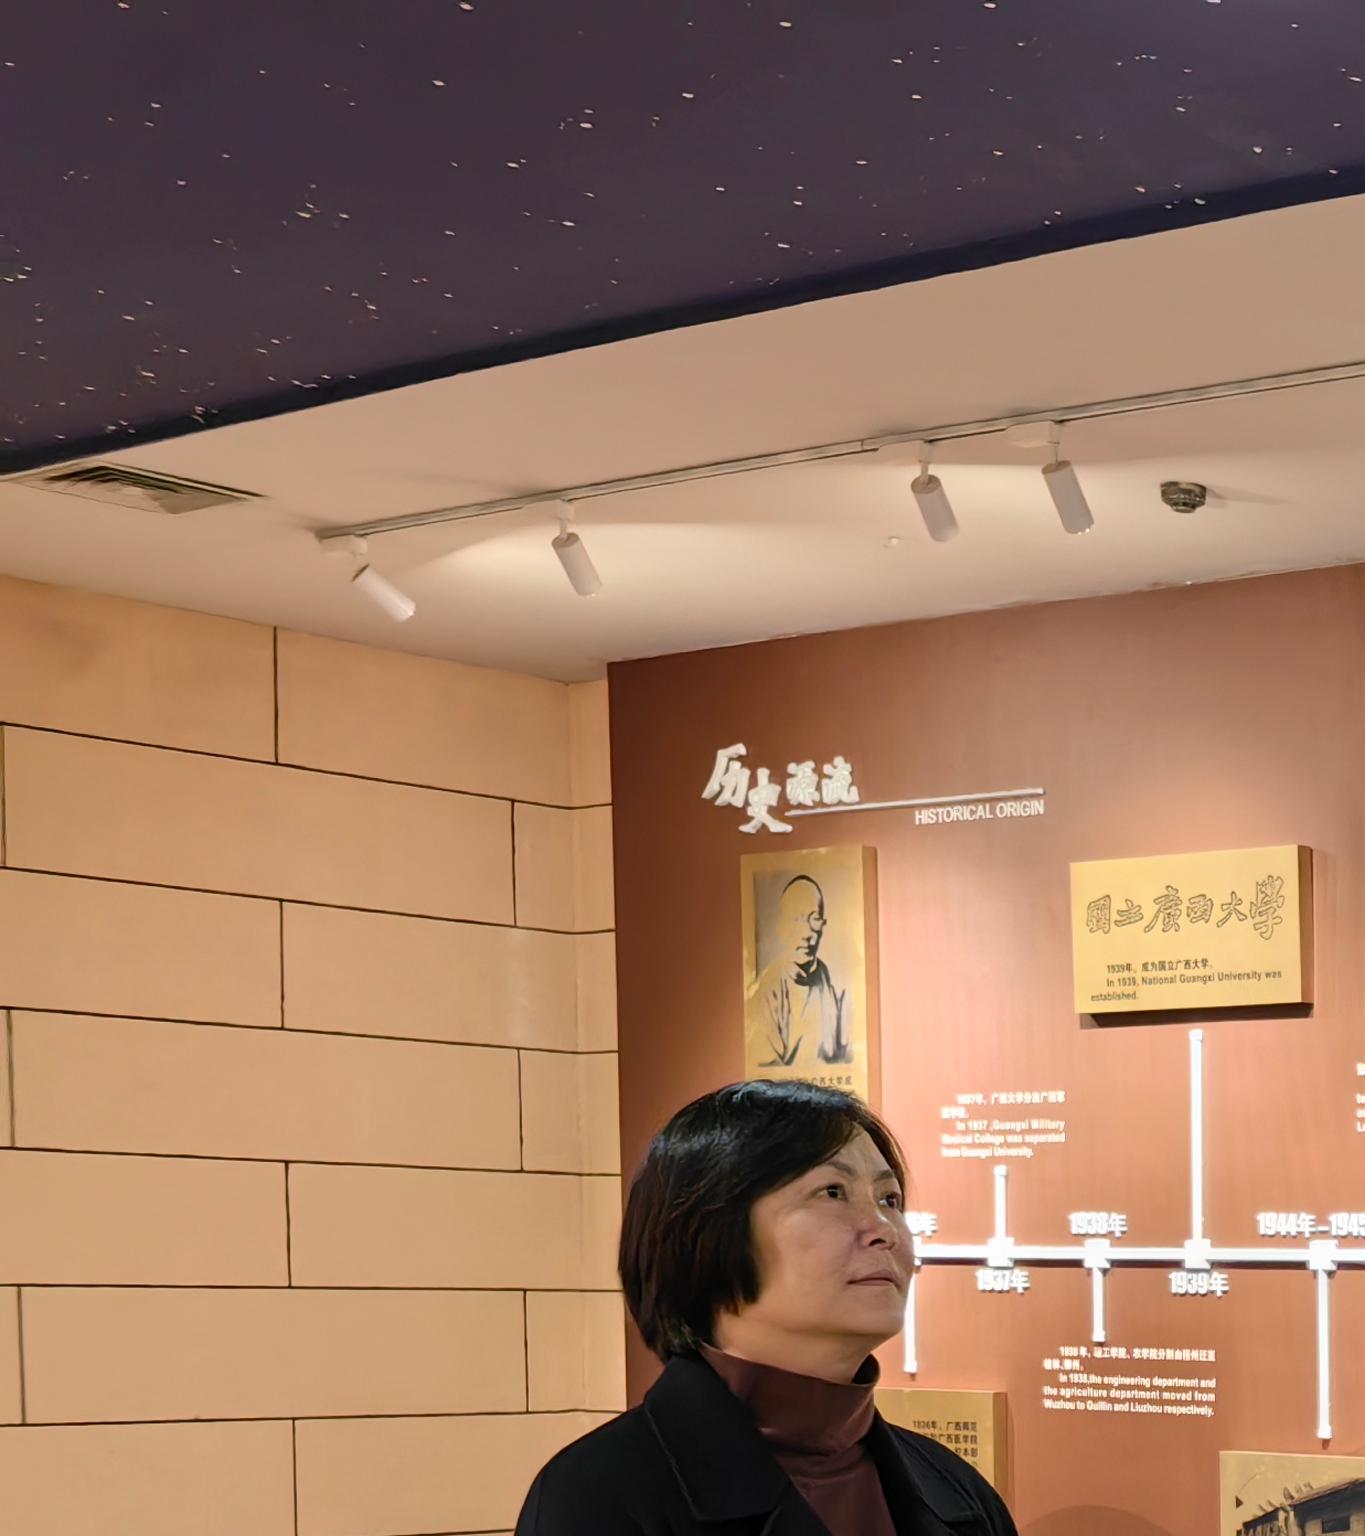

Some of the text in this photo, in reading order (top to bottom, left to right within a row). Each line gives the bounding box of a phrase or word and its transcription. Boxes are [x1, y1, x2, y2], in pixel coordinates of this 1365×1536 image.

[701, 742, 860, 834] 历史源流
[915, 800, 1044, 824] HISTORICAL ORIGIN
[1106, 978, 1115, 987] In
[1141, 974, 1177, 985] National
[1179, 973, 1215, 985] Guangxi
[1217, 971, 1262, 982] University
[1264, 970, 1282, 979] was
[1169, 1272, 1230, 1297] 1939年
